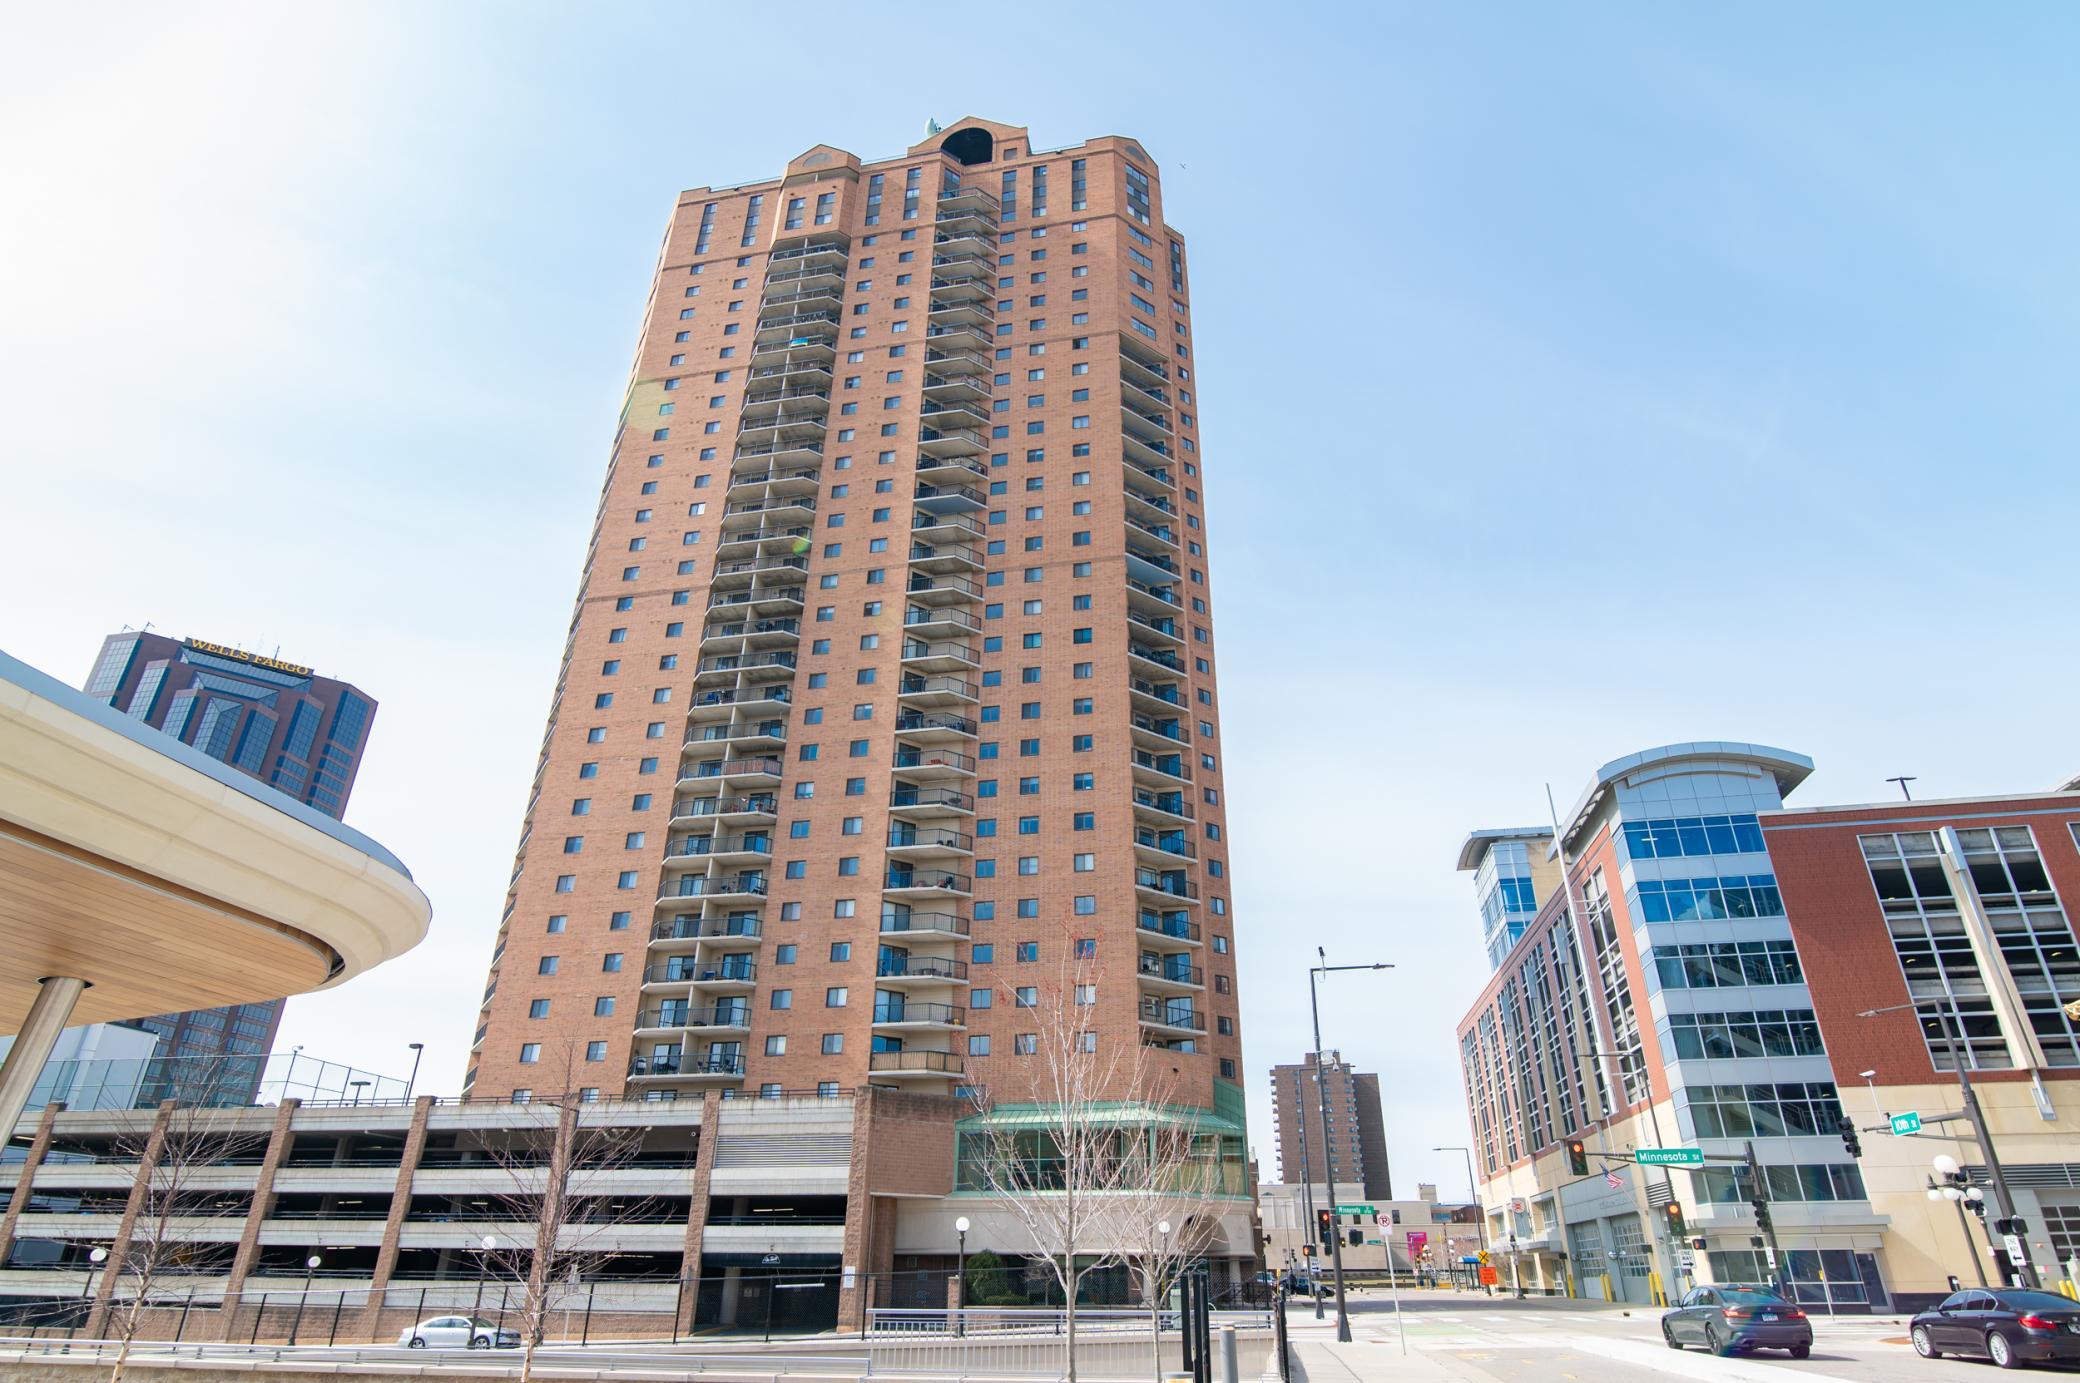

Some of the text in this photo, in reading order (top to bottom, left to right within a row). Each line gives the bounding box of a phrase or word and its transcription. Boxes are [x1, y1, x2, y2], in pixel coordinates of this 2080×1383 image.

[192, 639, 309, 675] WELLS FARGO
[1639, 1152, 1688, 1162] Minnesota
